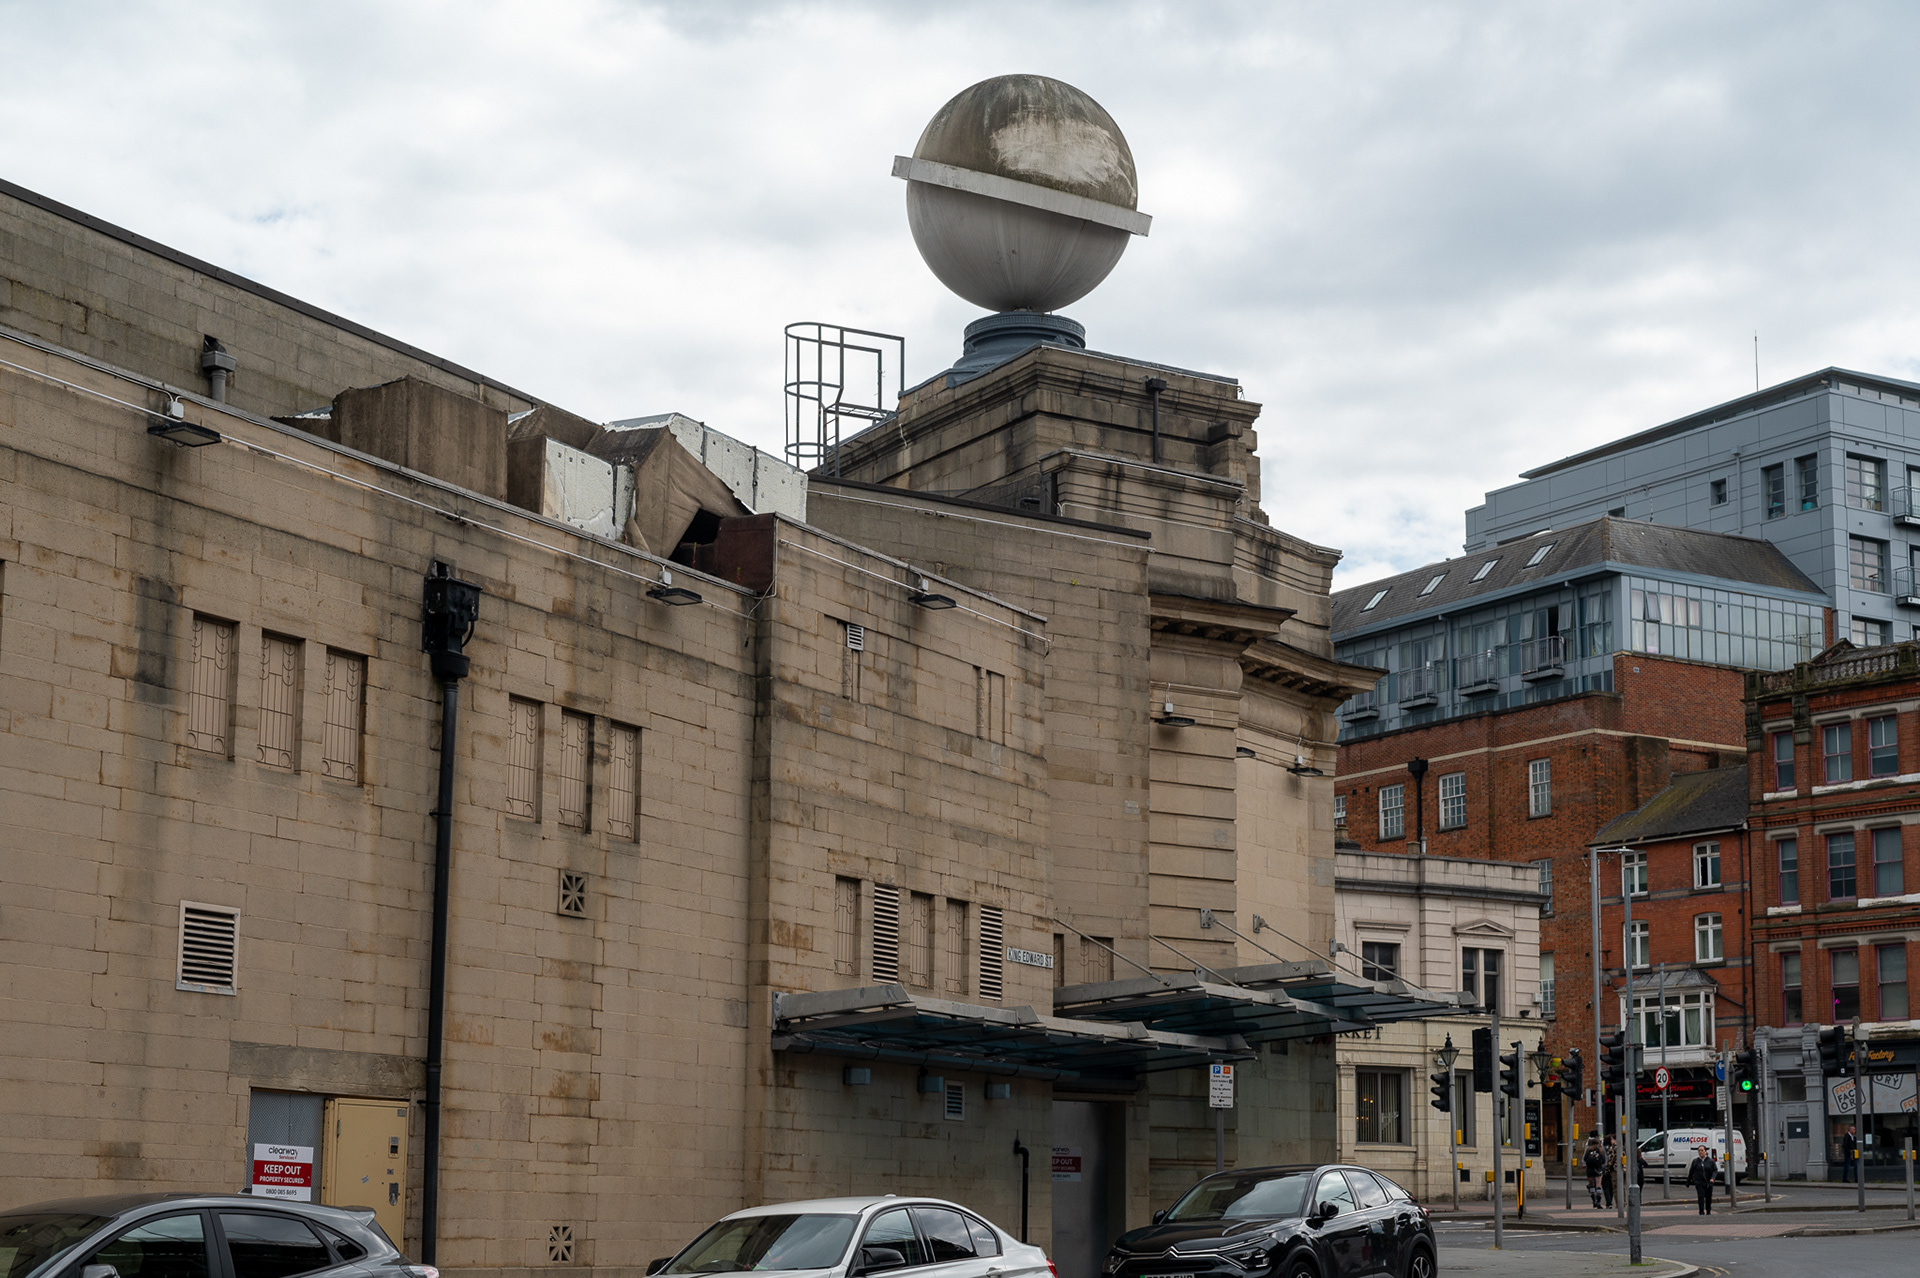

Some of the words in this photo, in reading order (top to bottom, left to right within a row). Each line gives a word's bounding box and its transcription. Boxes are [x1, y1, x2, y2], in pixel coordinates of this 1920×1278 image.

[1008, 948, 1021, 961] KING
[1023, 951, 1044, 965] EDWARD
[1045, 955, 1052, 966] ST
[1657, 1073, 1667, 1083] 20
[1838, 1088, 1855, 1103] FAC
[1841, 1098, 1856, 1110] OR
[268, 1147, 298, 1157] clearway
[264, 1164, 284, 1174] KEEP
[284, 1166, 301, 1175] OUT
